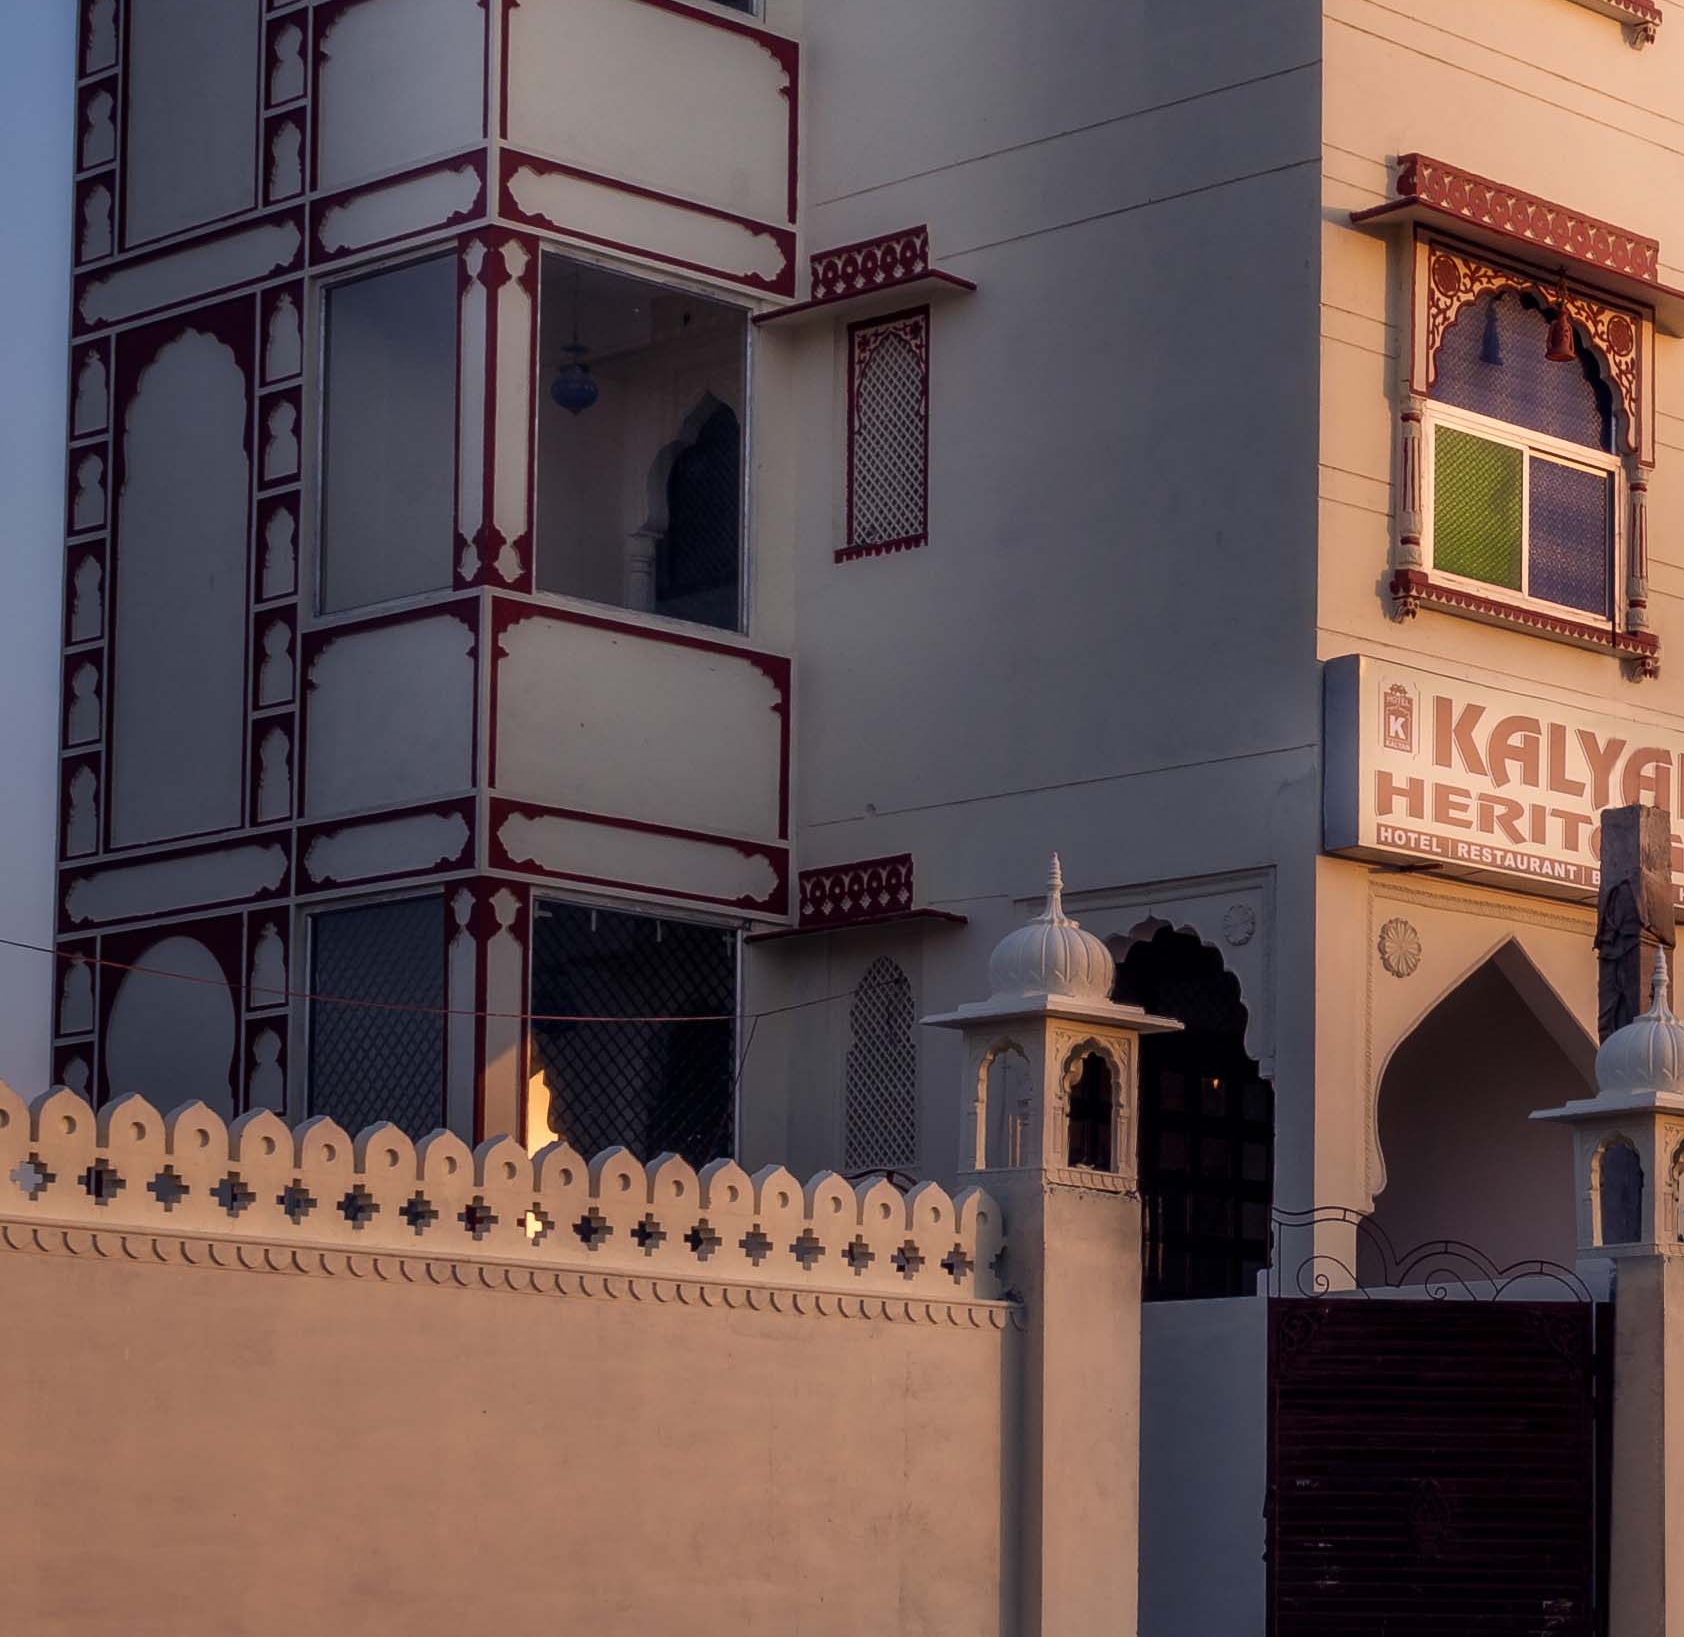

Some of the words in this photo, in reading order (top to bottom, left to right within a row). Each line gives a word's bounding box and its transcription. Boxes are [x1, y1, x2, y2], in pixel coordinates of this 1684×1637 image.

[1389, 714, 1406, 740] K
[1380, 827, 1442, 854] HOTEL
[1457, 842, 1577, 881] RESTAURANT
